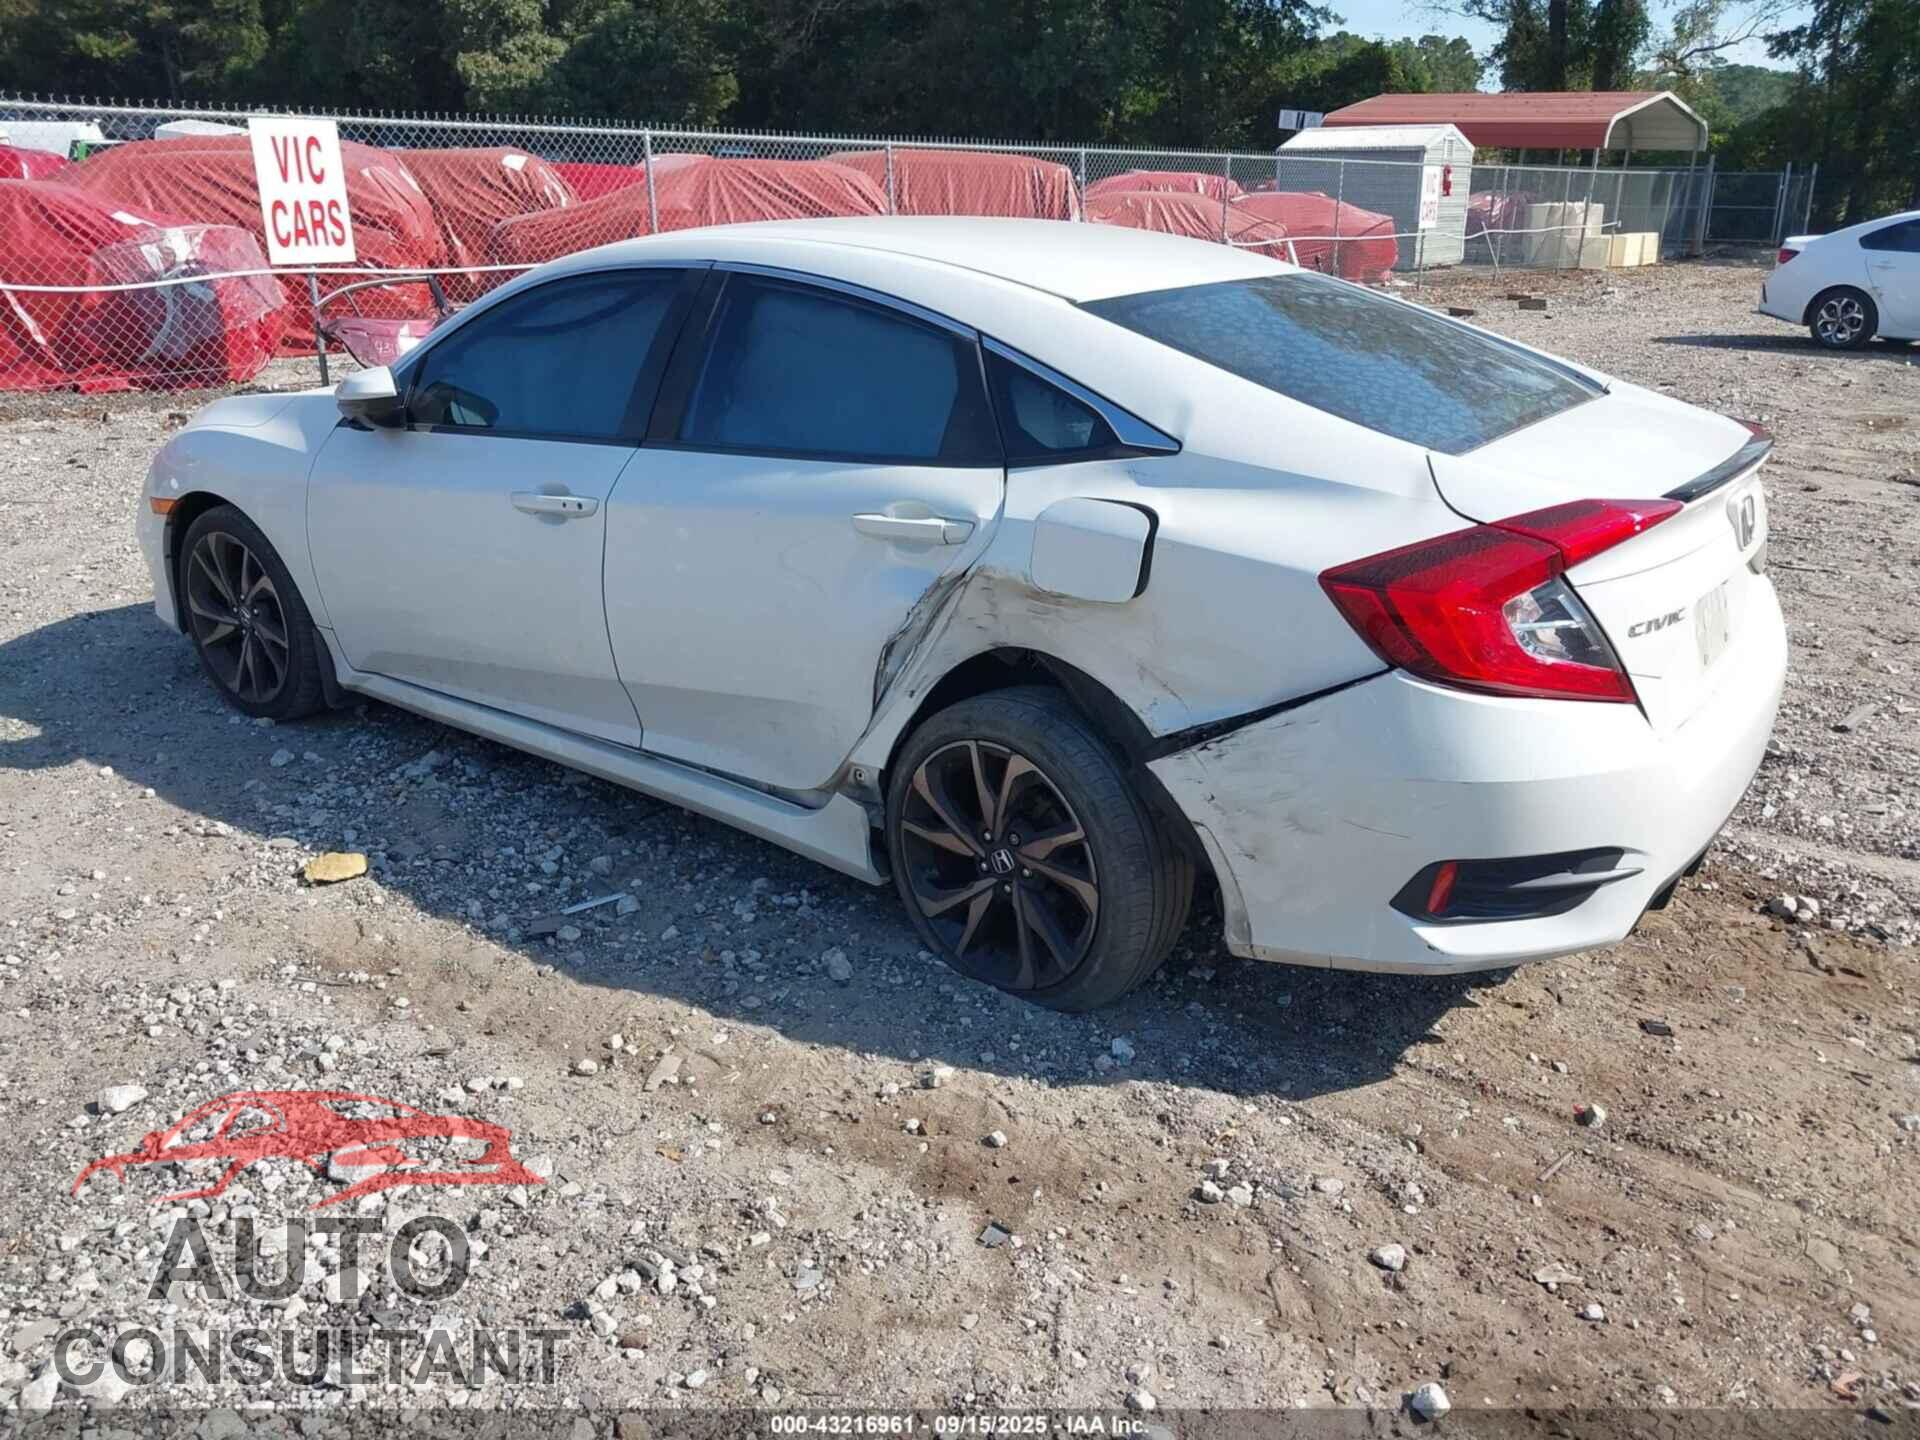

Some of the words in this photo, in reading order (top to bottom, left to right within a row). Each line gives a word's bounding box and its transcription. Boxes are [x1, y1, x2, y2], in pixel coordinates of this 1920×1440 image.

[270, 135, 325, 184] VIC
[271, 199, 346, 248] CARS
[1627, 606, 1687, 638] CIVIC
